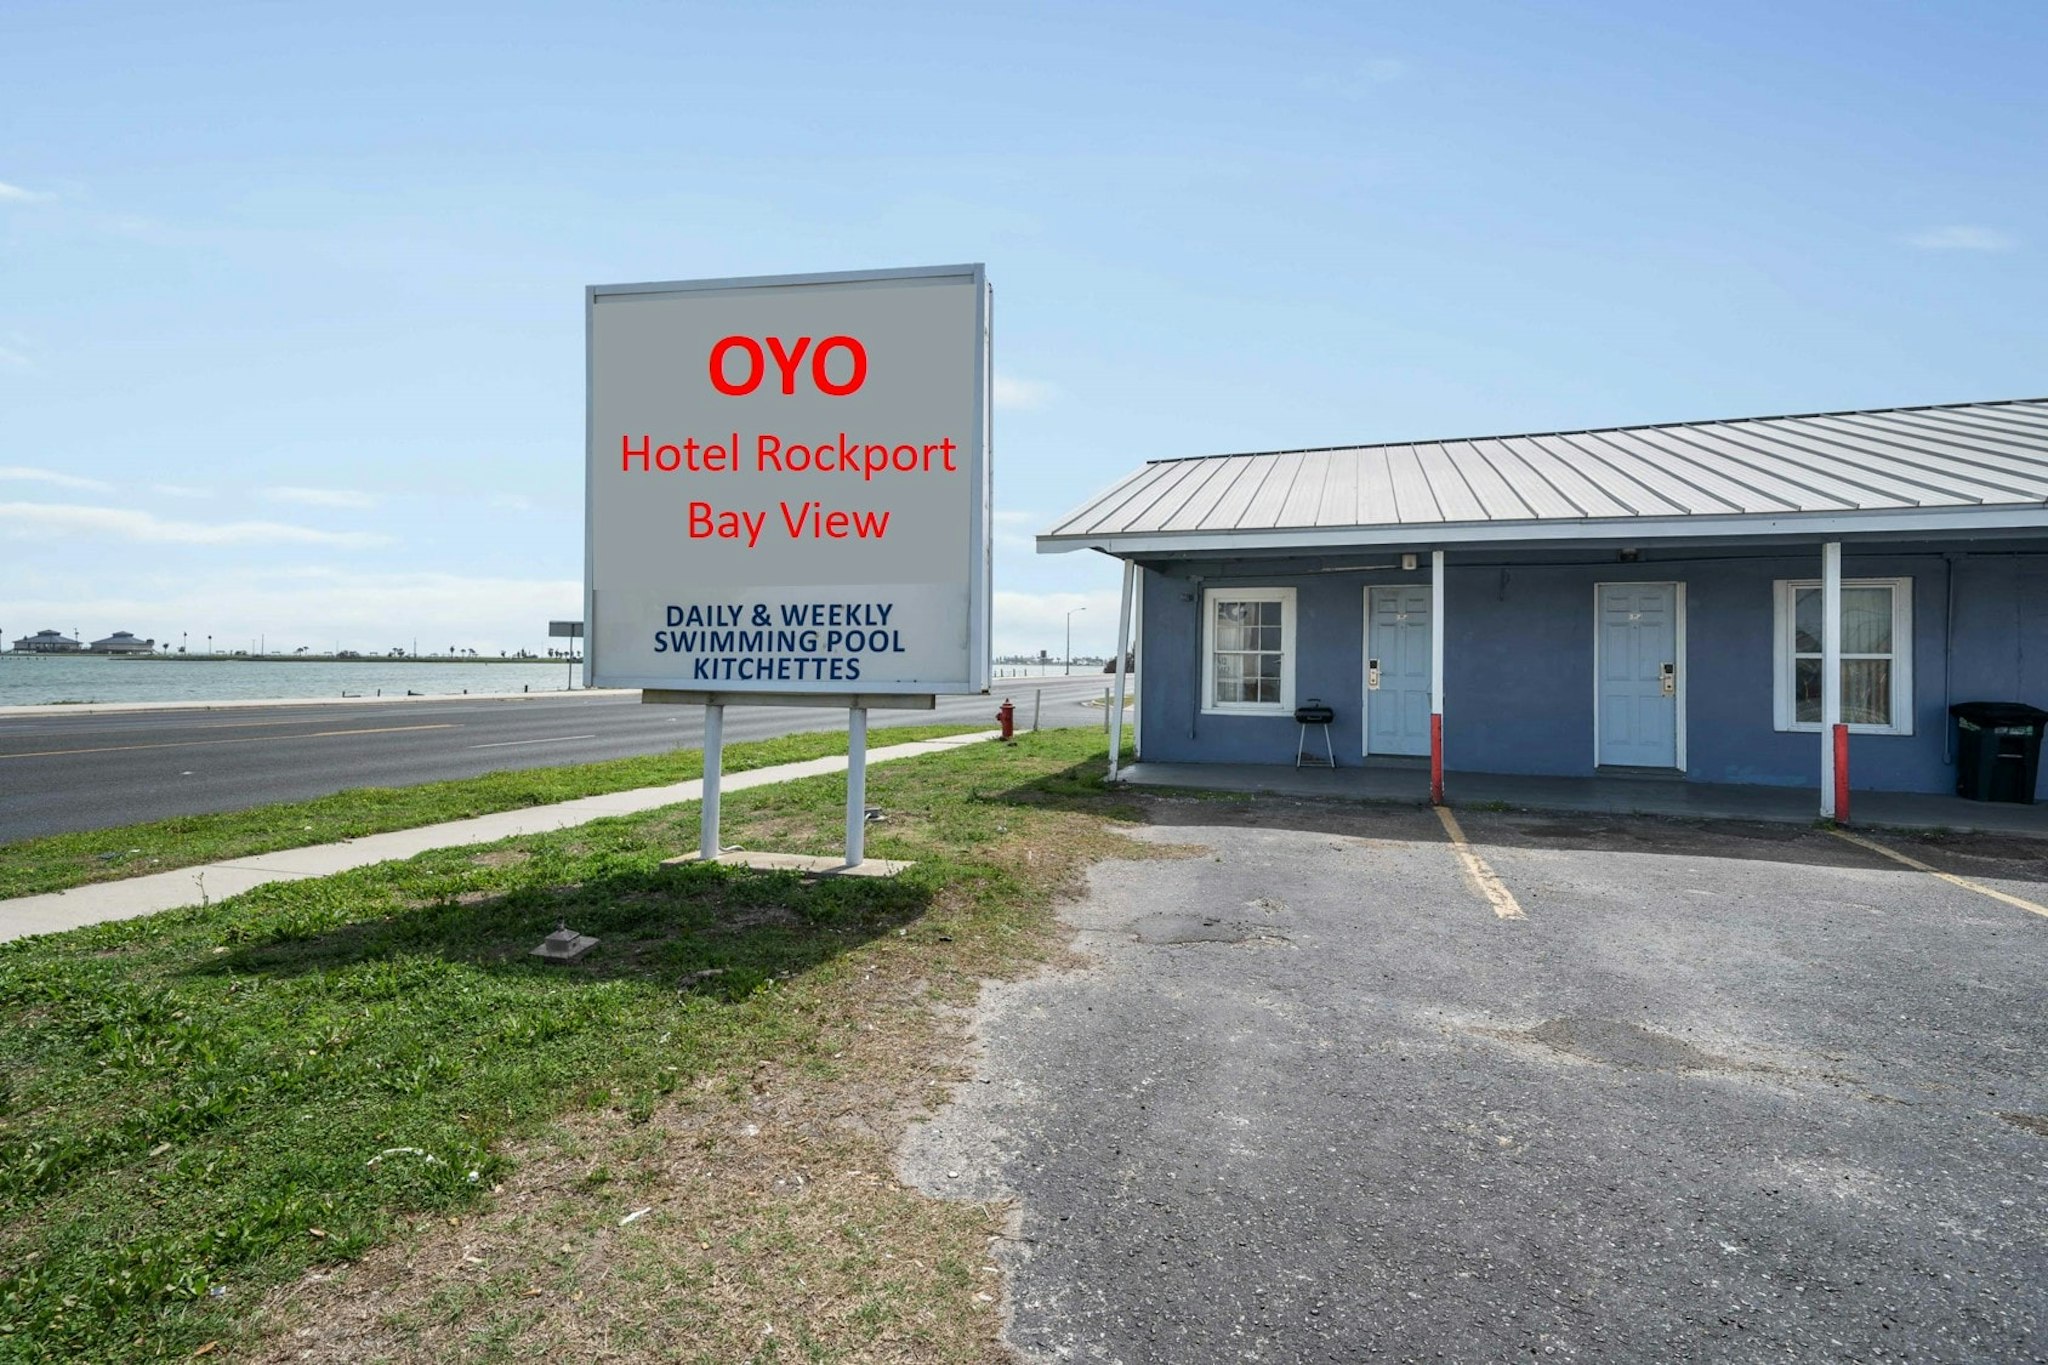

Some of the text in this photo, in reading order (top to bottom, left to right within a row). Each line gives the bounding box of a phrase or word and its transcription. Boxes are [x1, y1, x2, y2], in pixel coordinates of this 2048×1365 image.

[709, 336, 867, 396] OYO
[622, 433, 957, 481] Hotel Rockport
[689, 502, 890, 548] Bay View
[666, 604, 892, 627] DAILY & WEEKLY
[654, 630, 905, 653] SWIMMING POOL
[694, 658, 860, 680] KITCHETTES
